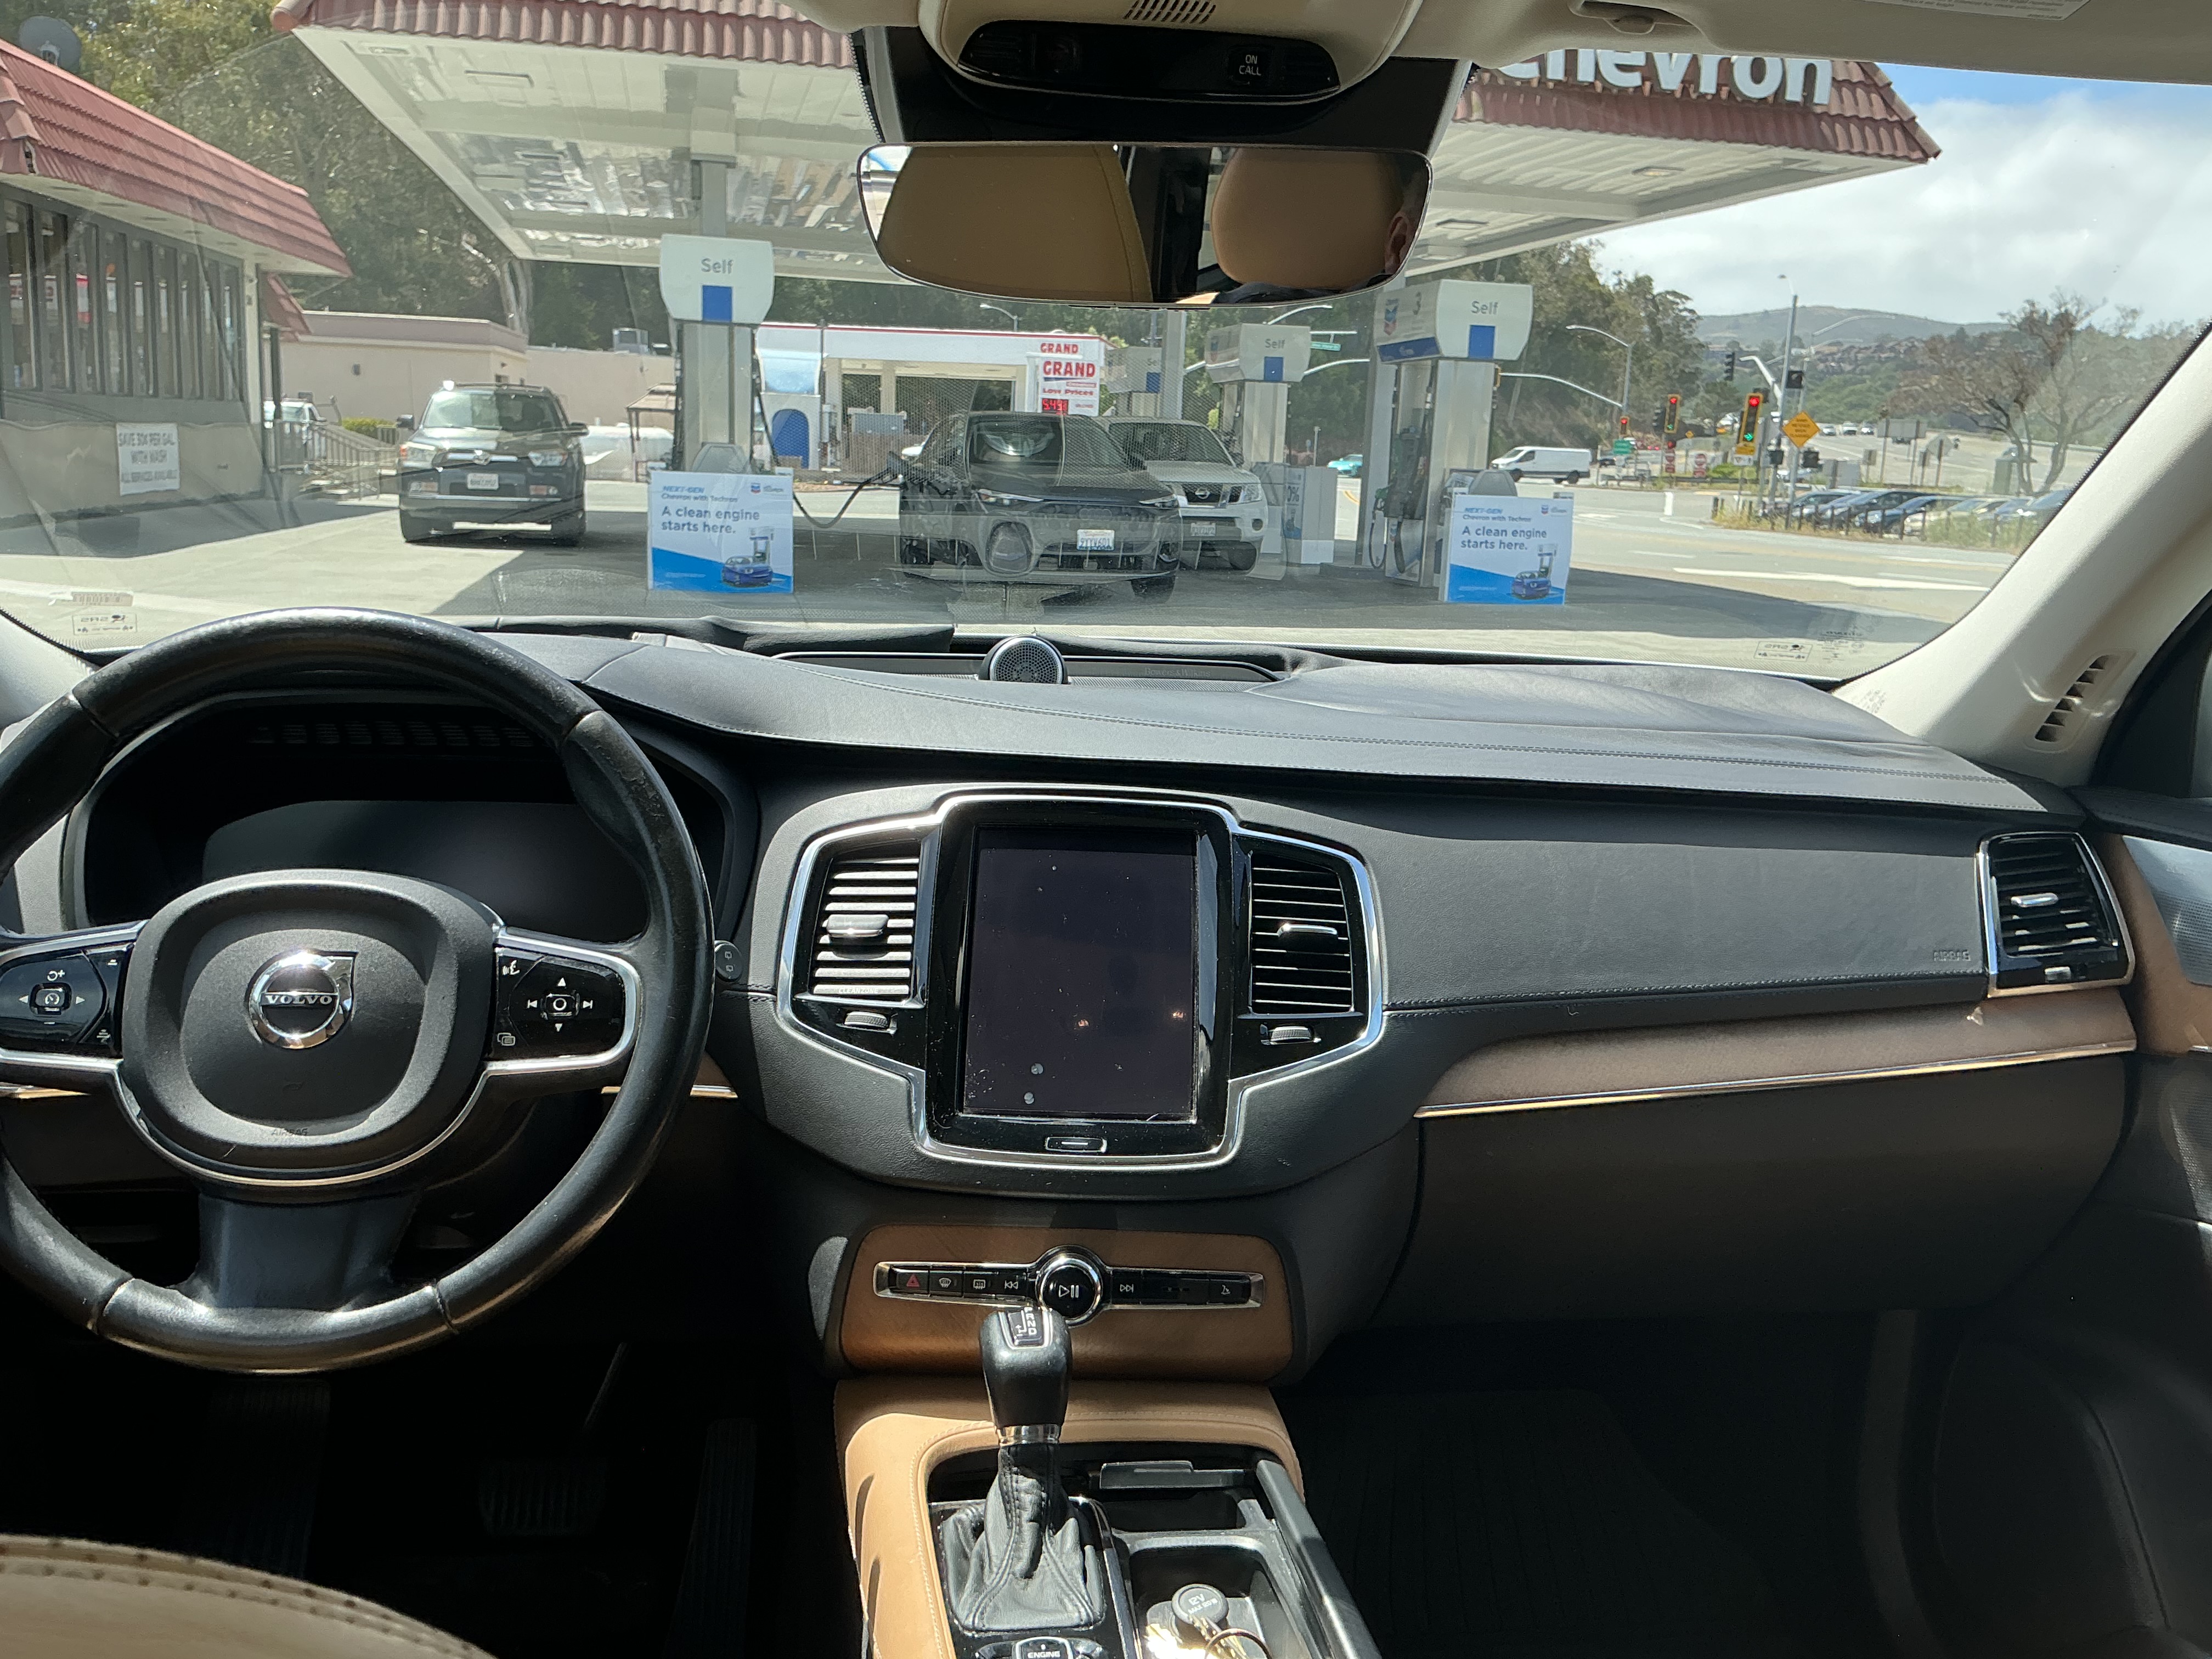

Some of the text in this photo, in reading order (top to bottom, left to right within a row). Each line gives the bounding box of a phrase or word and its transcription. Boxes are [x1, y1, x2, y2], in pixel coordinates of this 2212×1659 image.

[1245, 54, 1258, 64] ON
[1239, 65, 1262, 76] CALL
[701, 257, 734, 274] Self
[1471, 300, 1499, 315] Self
[1041, 342, 1079, 354] GRAND
[1265, 338, 1285, 349] Self
[1043, 360, 1096, 377] GRAND
[662, 506, 760, 522] A clean engine
[662, 521, 736, 534] starts here.
[1462, 526, 1548, 539] A clean engine
[1460, 539, 1528, 550] starts here.
[266, 995, 333, 1005] VOLVO
[1188, 1593, 1205, 1606] 12V
[1187, 1604, 1203, 1614] MAX
[1027, 1650, 1061, 1658] ENGINE
